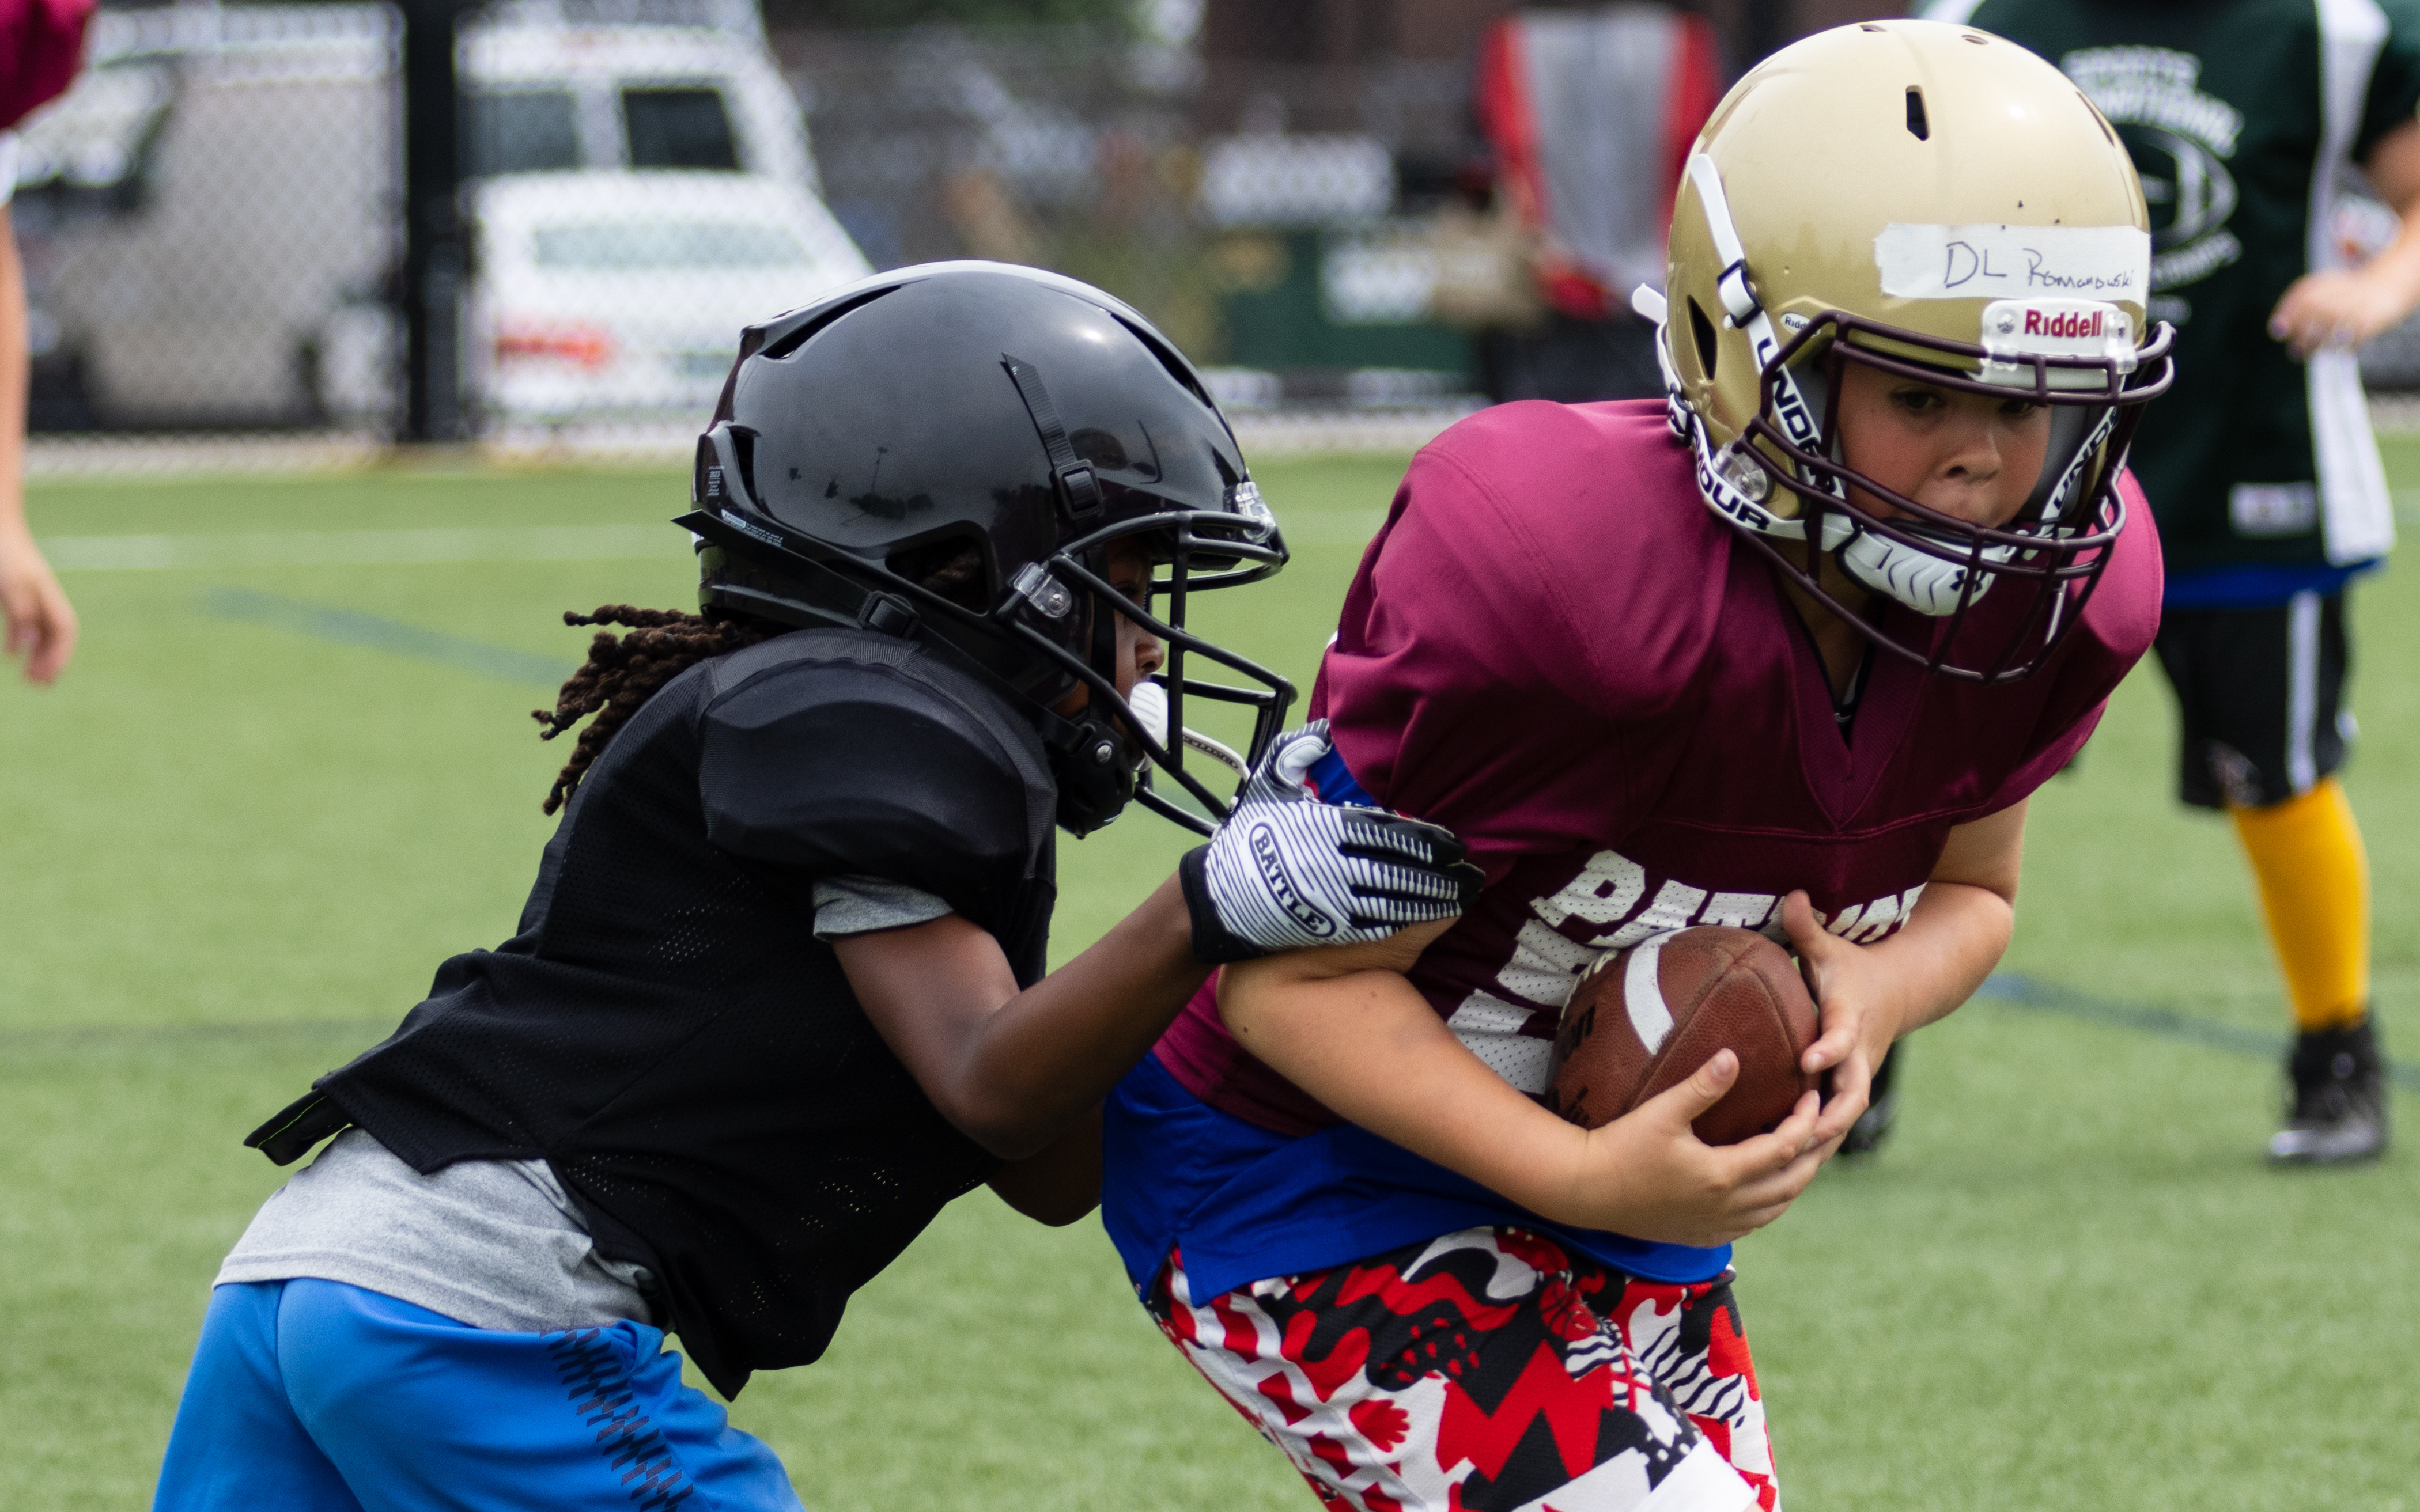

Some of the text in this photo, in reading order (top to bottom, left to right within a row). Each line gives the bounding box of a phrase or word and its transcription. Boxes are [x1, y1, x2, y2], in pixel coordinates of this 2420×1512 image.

[1944, 241, 2008, 288] DL
[2024, 309, 2103, 338] Riddell
[1254, 834, 1328, 931] BATTLE
